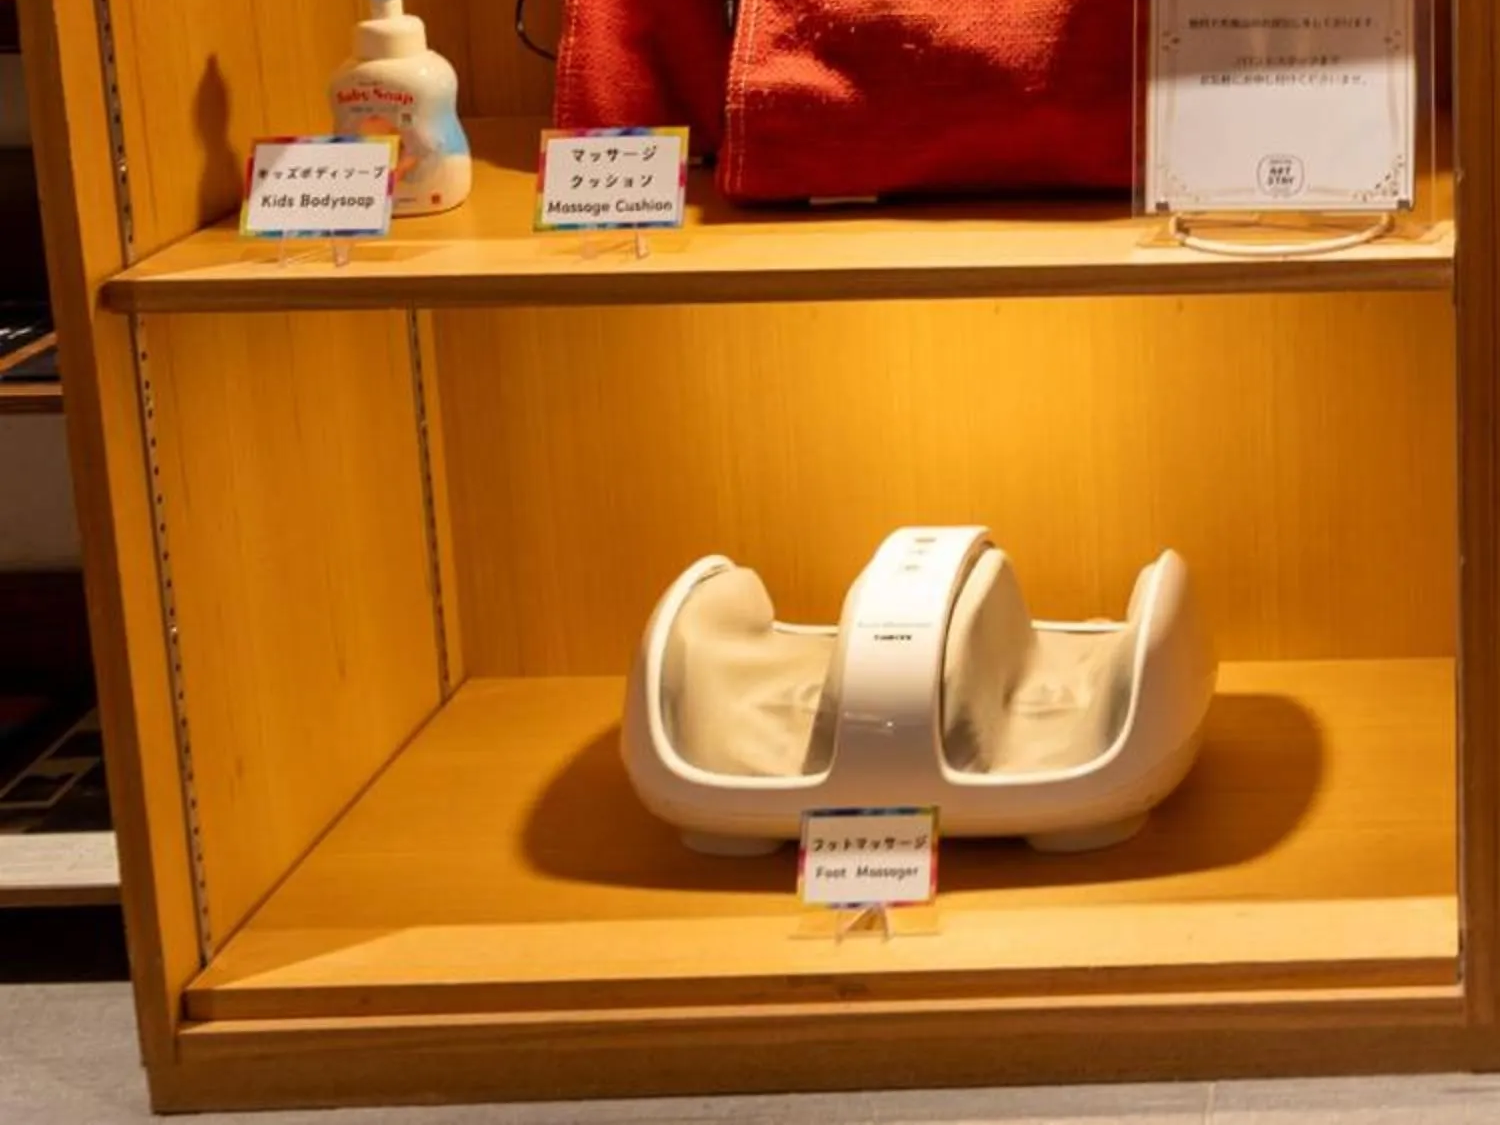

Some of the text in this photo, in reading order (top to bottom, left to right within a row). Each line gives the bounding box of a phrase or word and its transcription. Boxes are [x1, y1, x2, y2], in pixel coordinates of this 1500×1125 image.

[571, 145, 657, 162] マッサージ
[570, 174, 653, 189] クッション
[261, 192, 375, 209] Kids Bodysoap
[548, 198, 672, 217] Massage Cushion
[815, 864, 919, 881] Foot Massager
